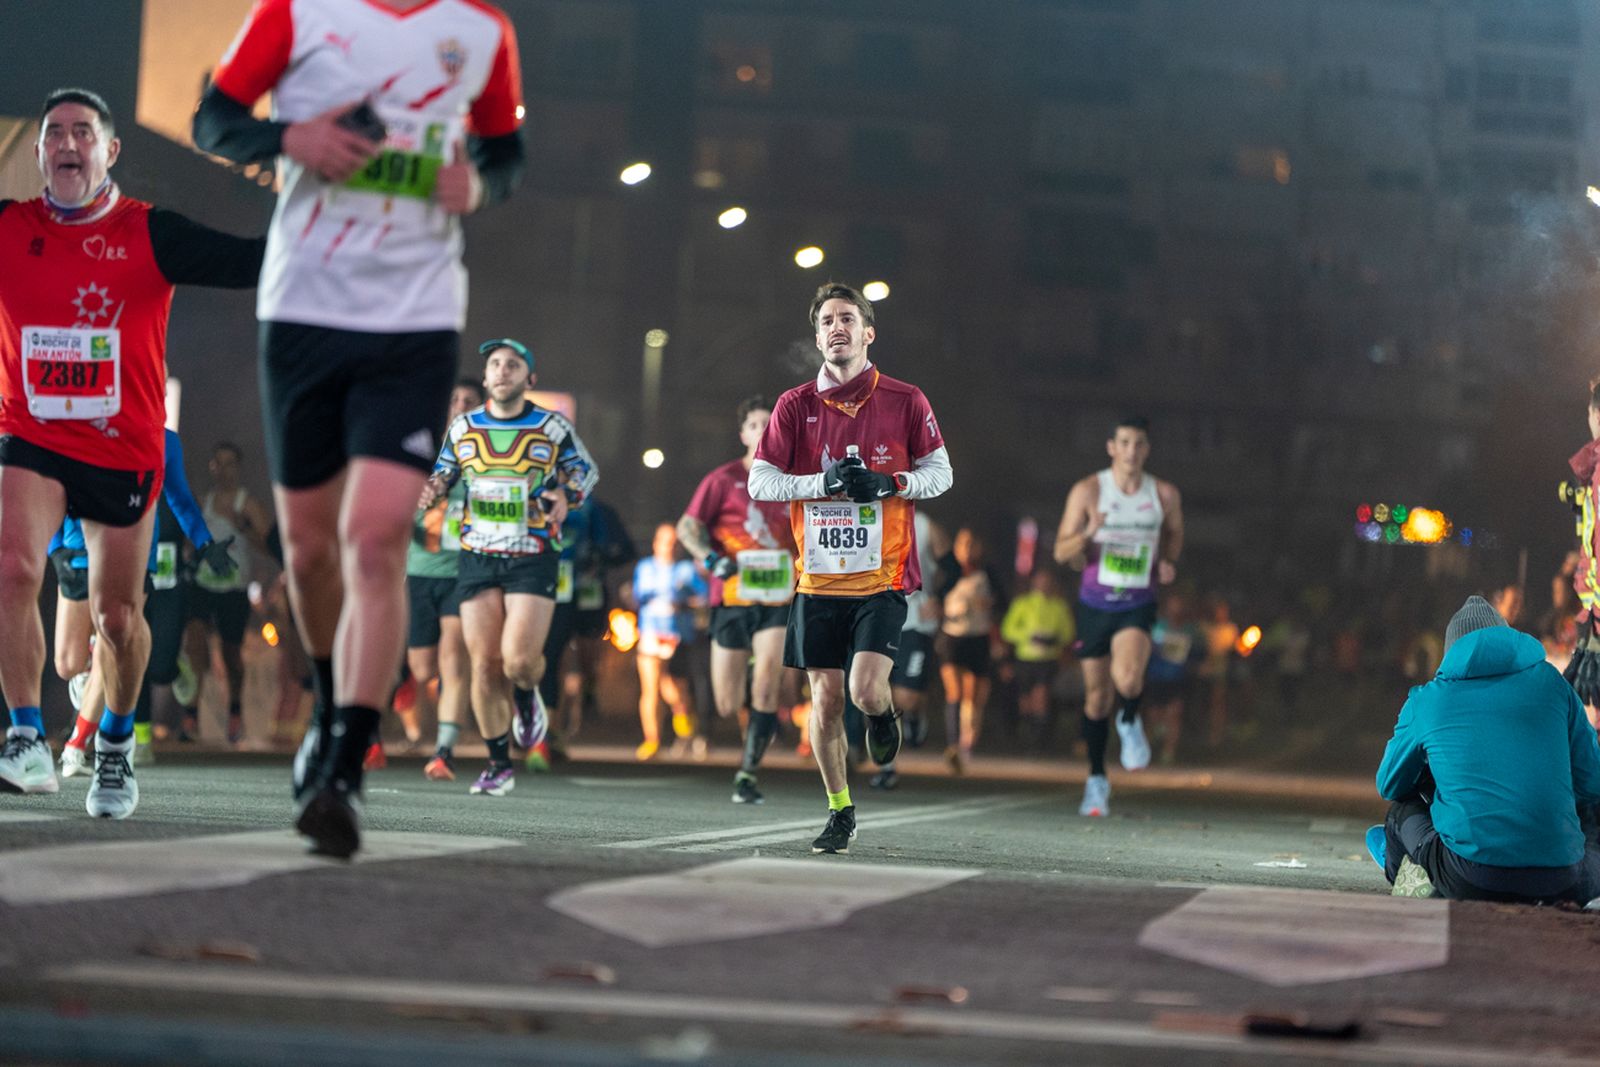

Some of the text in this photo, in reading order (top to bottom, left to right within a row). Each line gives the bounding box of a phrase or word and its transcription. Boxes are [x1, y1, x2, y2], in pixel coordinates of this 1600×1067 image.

[40, 361, 99, 388] 2387
[820, 509, 842, 517] NOCHE
[843, 508, 852, 517] DE
[813, 518, 827, 527] SAN
[828, 516, 853, 526] ANTÓN
[818, 527, 869, 549] 4839
